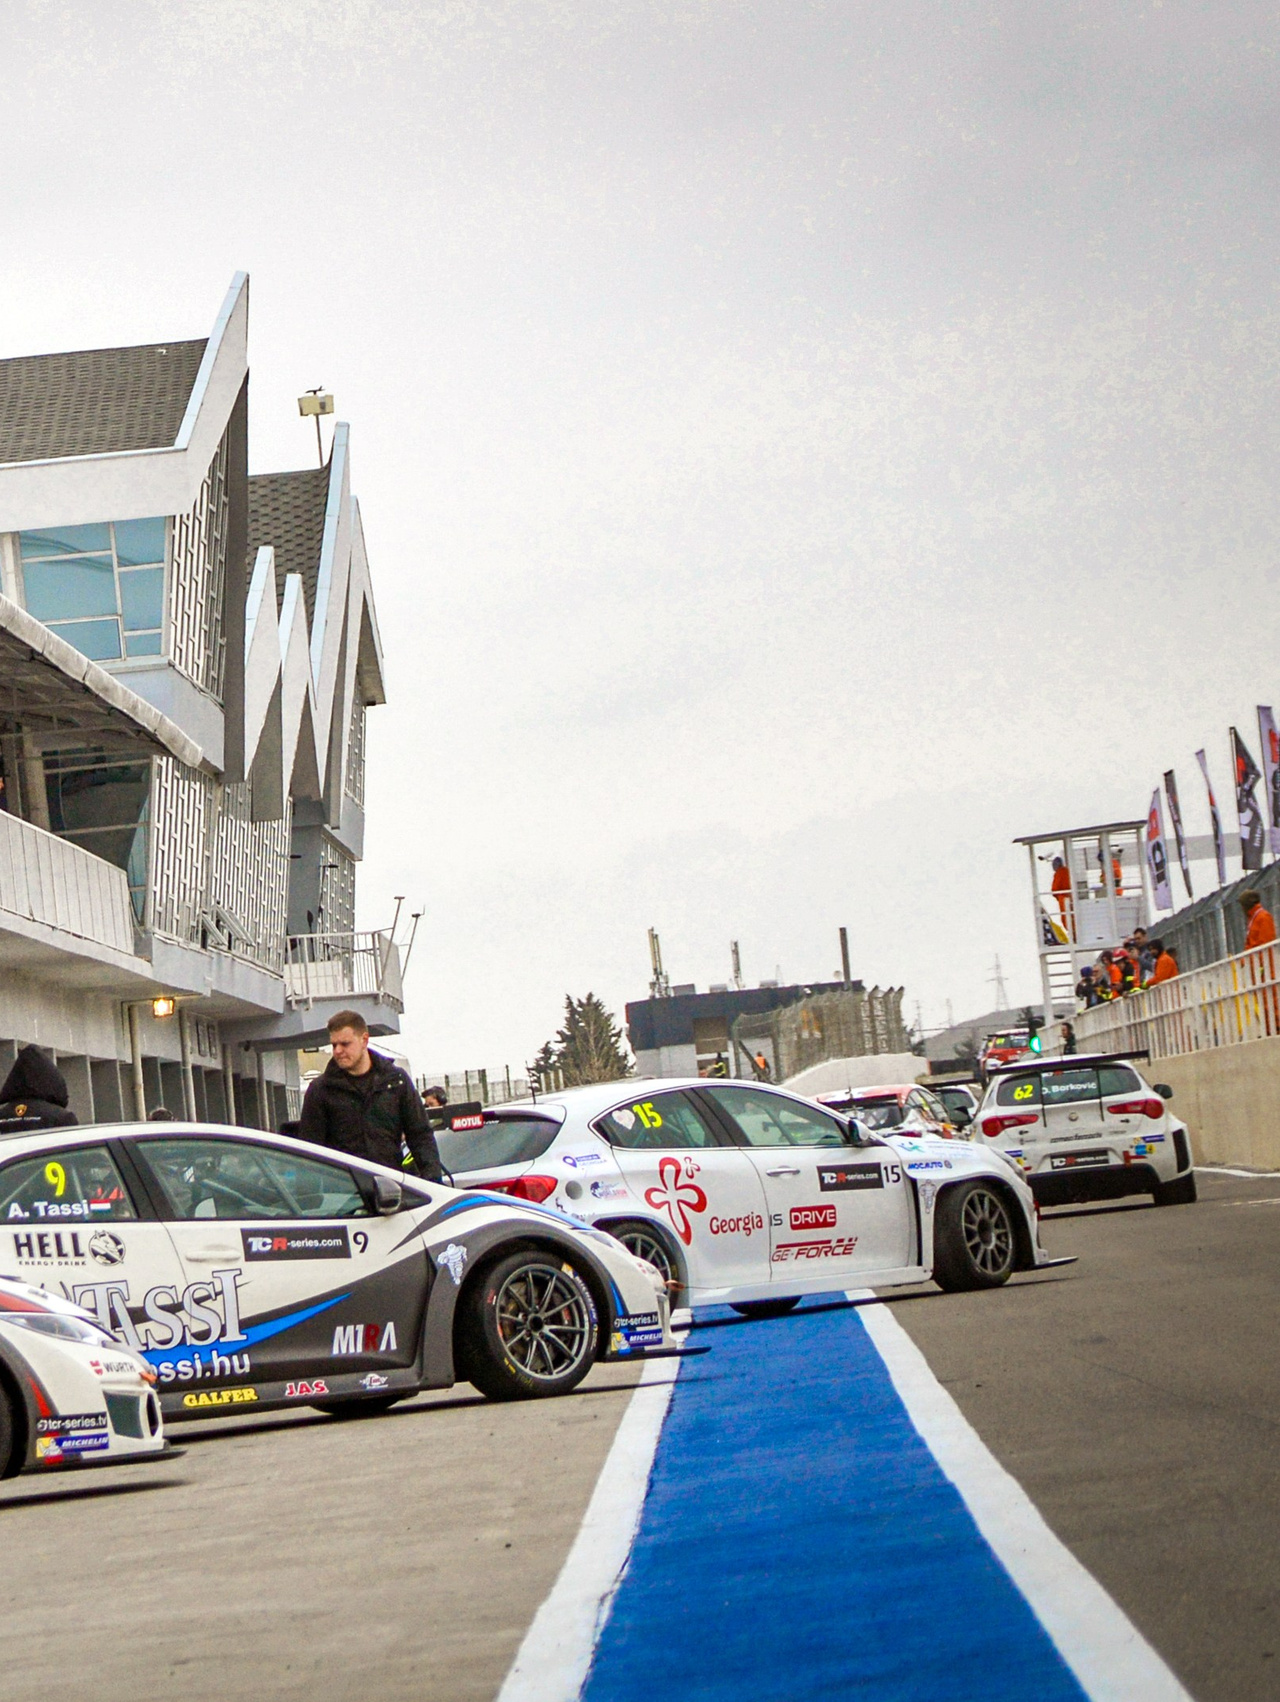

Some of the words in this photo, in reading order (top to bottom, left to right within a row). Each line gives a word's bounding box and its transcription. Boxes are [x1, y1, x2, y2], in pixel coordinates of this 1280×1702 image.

[1014, 1085, 1033, 1100] 62
[453, 1116, 482, 1129] MOTUL
[632, 1102, 663, 1128] 15
[45, 1162, 66, 1196] 9
[883, 1165, 901, 1183] 15
[8, 1202, 30, 1218] A.
[33, 1200, 89, 1216] Tassi
[709, 1212, 763, 1236] Georgia
[770, 1213, 783, 1226] IS
[791, 1209, 836, 1225] DRIVE
[13, 1232, 85, 1258] HELL
[247, 1237, 343, 1252] TCR-series.com
[352, 1231, 369, 1253] 9
[72, 1268, 248, 1351] TASSI
[183, 1387, 259, 1407] GALFER
[285, 1380, 330, 1397] JAS
[48, 1415, 107, 1430] tcr-series.tv
[61, 1437, 109, 1448] MICHELIN
